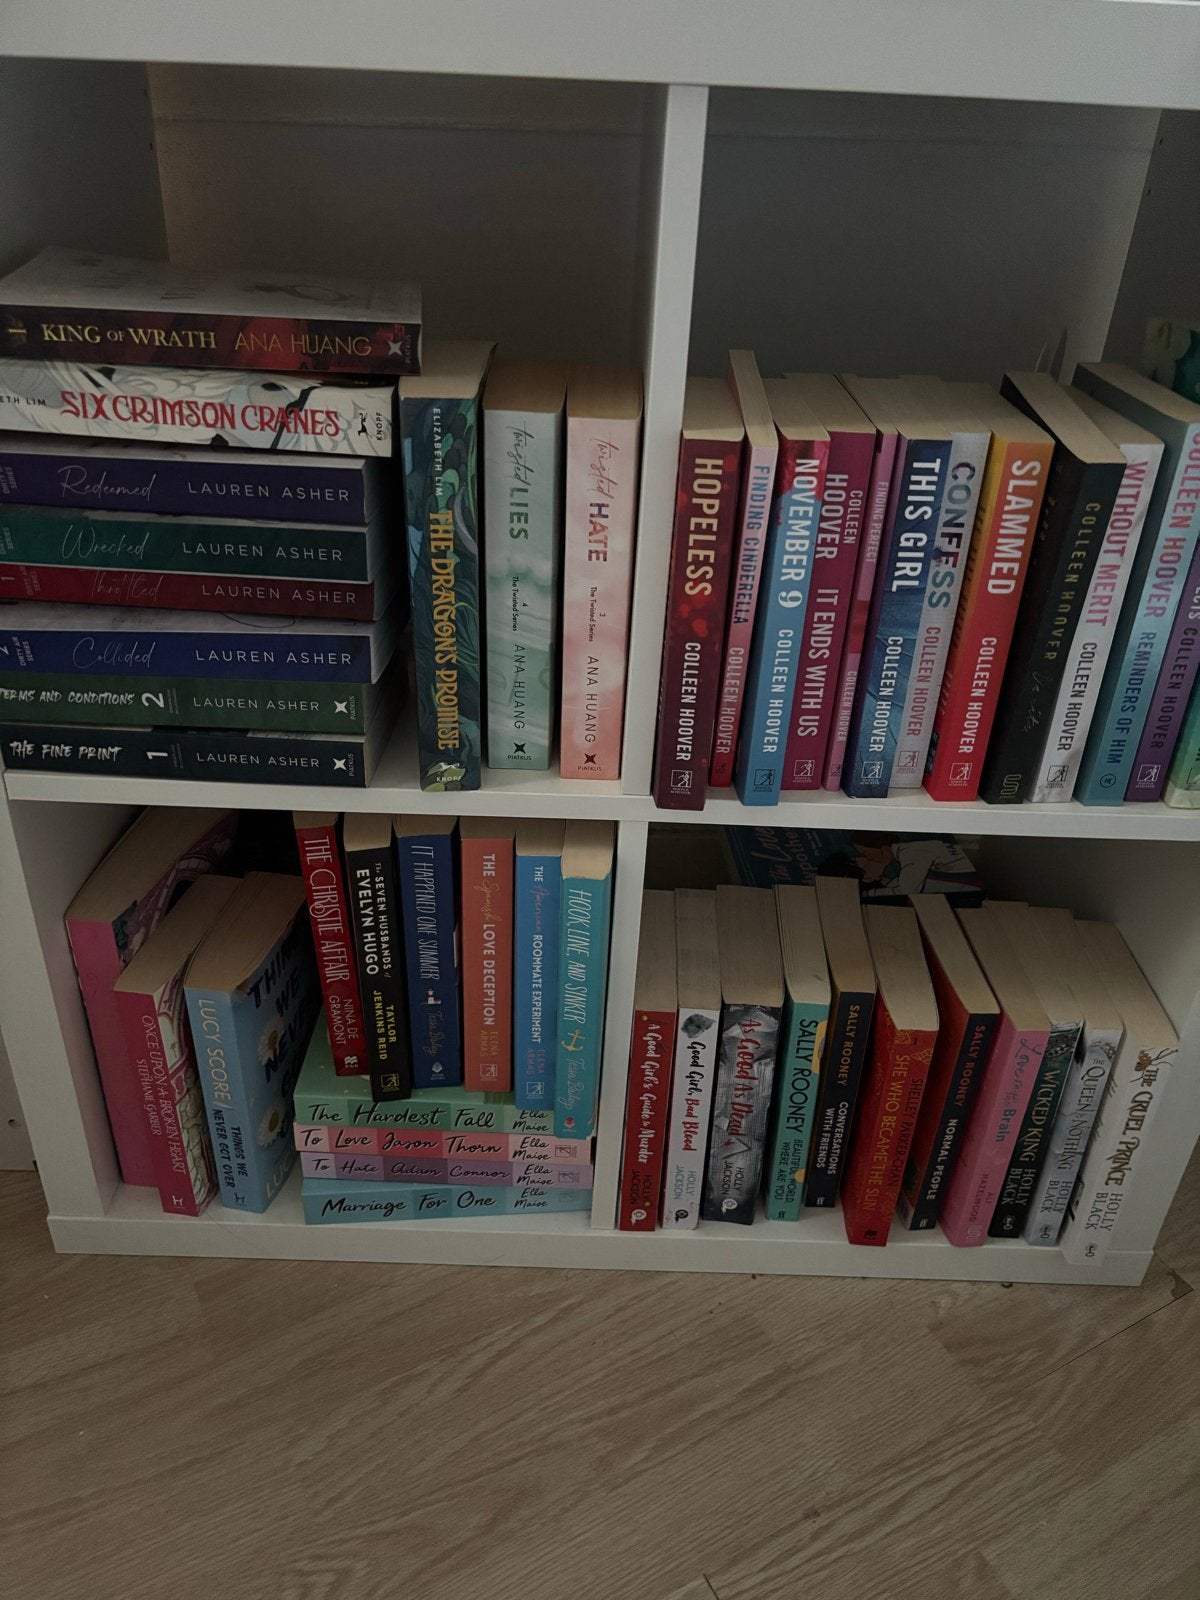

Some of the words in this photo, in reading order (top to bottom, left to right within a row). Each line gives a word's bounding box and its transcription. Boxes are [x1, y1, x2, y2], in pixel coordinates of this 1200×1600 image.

[41, 323, 102, 344] KING
[128, 327, 217, 349] WRATH
[234, 331, 283, 352] ANA
[291, 334, 372, 357] HUANG
[26, 397, 47, 406] LIM
[61, 391, 111, 421] SIX
[112, 395, 236, 429] CRIMSON
[241, 405, 340, 437] CRANES
[432, 407, 444, 472] ELIZABETH
[57, 465, 157, 502] Redeemed
[188, 481, 270, 498] LAUREN
[281, 486, 350, 502] ASHER
[435, 475, 444, 498] LIM
[746, 465, 771, 531] FINDING
[903, 457, 941, 521] THIS
[508, 487, 530, 541] LIES
[684, 457, 724, 597] HOPELESS
[780, 458, 820, 582] NOVEMBER
[815, 473, 849, 559] HOOVER
[842, 490, 864, 544] COLLEEN
[987, 457, 1042, 595] SLAMMED
[1103, 461, 1148, 557] WITHOUT
[61, 525, 150, 560] Wrecked
[182, 541, 263, 557] LAUREN
[275, 545, 343, 562] ASHER
[587, 502, 610, 563] HATE
[927, 462, 976, 609] CONFESS
[1064, 502, 1101, 584] COLLEEN
[733, 537, 760, 625] CINDERELLA
[891, 532, 928, 593] GIRL
[1144, 537, 1187, 619] HOOVER
[202, 584, 280, 600] LAUREN
[292, 588, 356, 604] ASHER
[1086, 564, 1121, 627] MERIT
[73, 637, 156, 670] Collided
[195, 649, 275, 664] LAUREN
[286, 652, 352, 666] ASHER
[808, 611, 836, 660] ENDS
[917, 626, 942, 683] COLLEEN
[513, 644, 526, 674] ANA
[586, 655, 600, 686] ANA
[680, 642, 701, 705] COLLEEN
[722, 647, 744, 703] COLLEEN
[771, 629, 794, 693] COLLEEN
[879, 636, 904, 696] COLLEEN
[971, 637, 998, 697] COLLEEN
[1070, 642, 1098, 699] COLLEEN
[1120, 632, 1157, 713] REMINDERS
[1167, 627, 1199, 690] COLLEEN
[39, 689, 63, 702] AND
[67, 691, 135, 706] CONDITIONS
[193, 696, 258, 709] LAUREN
[266, 700, 320, 712] ASHER
[513, 681, 526, 730] HUANG
[801, 664, 828, 709] WITH
[435, 668, 461, 752] PROMISE
[584, 693, 599, 743] HUANG
[716, 707, 737, 754] HOOVER
[762, 699, 784, 753] HOOVER
[797, 715, 820, 737] US
[868, 701, 892, 752] HOOVER
[906, 688, 929, 737] HOOVER
[958, 702, 984, 754] HOOVER
[1057, 702, 1083, 751] HOOVER
[1151, 696, 1178, 749] HOOVER
[9, 739, 36, 760] THE
[41, 743, 73, 760] FINE
[78, 746, 123, 762] PRINT
[675, 708, 697, 761] HOOVER
[1106, 739, 1128, 765] HIM
[196, 752, 260, 765] LAUREN
[267, 755, 320, 768] ASHER
[303, 835, 333, 865] THE
[482, 854, 496, 877] THE
[375, 876, 387, 912] SEVEN
[413, 862, 437, 914] HAPPENED
[534, 866, 544, 882] THE
[309, 868, 345, 936] CHRISTIE
[356, 869, 375, 927] EVELYN
[378, 915, 393, 970] HUSBANDS
[416, 915, 438, 936] ONE
[483, 925, 496, 955] LOVE
[320, 939, 350, 983] AFFAIR
[363, 932, 380, 975] HUGO
[417, 938, 441, 981] SUMMER
[532, 934, 544, 989] ROOMMATE
[373, 989, 385, 1035] JENKINS
[483, 959, 496, 1025] DECEPTION
[563, 981, 588, 1024] SINKER
[198, 999, 222, 1044] LUCY
[328, 995, 347, 1046] GRAMONT
[385, 1004, 398, 1044] TAYLOR
[531, 991, 542, 1044] EXPERIMENT
[848, 1004, 861, 1039] SALLY
[377, 1037, 388, 1061] REID
[686, 1041, 707, 1069] Good
[734, 1038, 762, 1081] Good
[795, 1019, 819, 1067] SALLY
[837, 1041, 854, 1087] ROONEY
[968, 1025, 987, 1059] SALLY
[207, 1047, 232, 1101] SCORE
[953, 1061, 977, 1107] ROONEY
[308, 1103, 343, 1121] The
[353, 1102, 446, 1125] Hardest
[455, 1108, 496, 1128] Fall
[684, 1098, 701, 1119] Bad
[785, 1067, 812, 1134] ROONEY
[1031, 1069, 1061, 1126] WICKED
[1122, 1091, 1154, 1136] CRUEL
[301, 1128, 323, 1146] To
[335, 1129, 373, 1149] Love
[382, 1132, 437, 1150] Jason
[445, 1135, 503, 1154] Thorn
[512, 1121, 550, 1132] Maise
[519, 1137, 549, 1149] Ella
[682, 1121, 700, 1152] Blood
[827, 1102, 849, 1175] CONVERSATIONS
[937, 1117, 959, 1162] NORMAL
[1019, 1127, 1044, 1163] KING
[312, 1158, 331, 1172] To
[339, 1160, 379, 1174] Hate
[450, 1165, 511, 1178] Connor
[512, 1150, 551, 1161] Maise
[523, 1164, 553, 1175] Ella
[815, 1133, 831, 1169] FRIENDS
[1104, 1137, 1141, 1187] PRINCE
[223, 1164, 236, 1188] OVER
[516, 1175, 555, 1186] Maise
[520, 1188, 548, 1199] Ella
[673, 1164, 685, 1200] JACKSON
[685, 1170, 697, 1196] HOLLY
[721, 1159, 734, 1196] JACKSON
[733, 1167, 744, 1193] HOLLY
[925, 1164, 945, 1200] PEOPLE
[1000, 1168, 1023, 1206] BLACK
[1014, 1168, 1037, 1206] HOLLY
[321, 1197, 408, 1217] Marriage
[418, 1193, 447, 1211] For
[457, 1191, 497, 1209] One
[513, 1198, 550, 1209] Maise
[1085, 1192, 1109, 1230] BLACK
[1100, 1193, 1124, 1232] HOLLY
